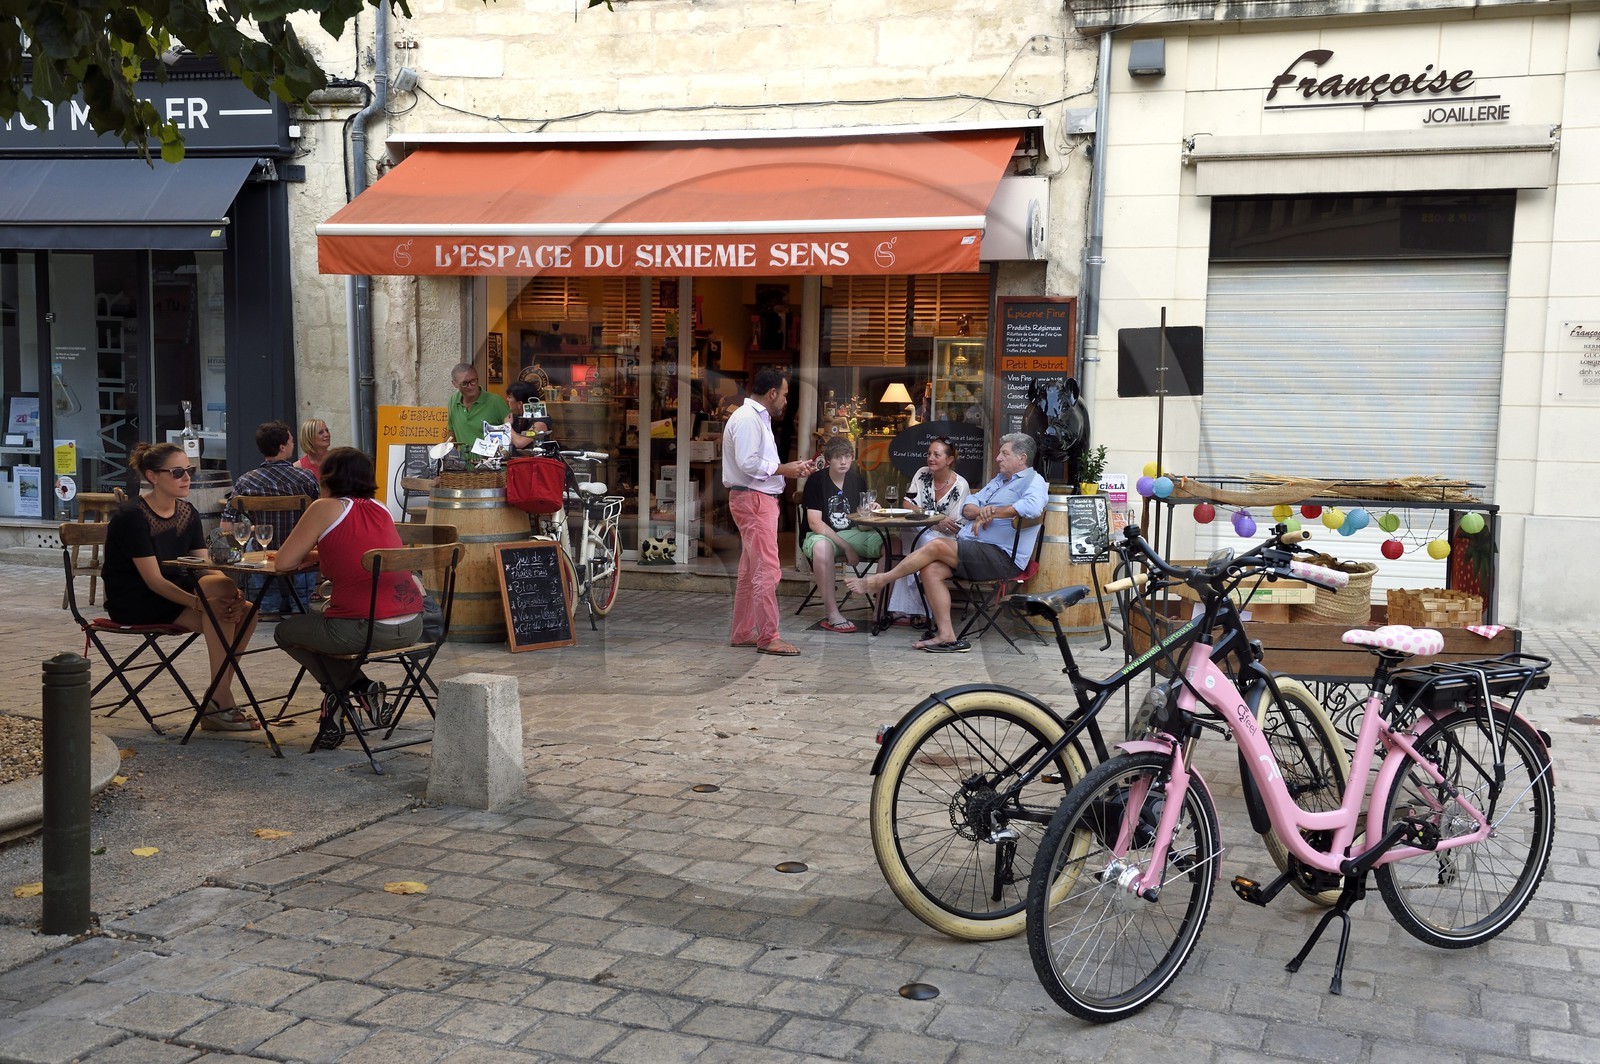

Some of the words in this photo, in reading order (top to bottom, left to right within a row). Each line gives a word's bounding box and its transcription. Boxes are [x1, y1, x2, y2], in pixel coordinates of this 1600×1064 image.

[1266, 49, 1475, 109] Françoise
[1423, 104, 1511, 124] JOAILLERIE
[434, 243, 572, 269] L'ESPACE
[584, 242, 625, 270] DU
[635, 241, 757, 268] SIXIEME
[769, 241, 850, 267] SENS
[1046, 308, 1066, 319] Fine
[1006, 360, 1027, 369] Petit
[1032, 360, 1064, 370] Bistrot
[94, 290, 127, 486] MAHLER
[400, 410, 448, 422] L'ESPACE
[383, 426, 397, 436] DU
[399, 426, 439, 437] SIXIEME
[1121, 622, 1194, 675] www.unveloourtous.fr
